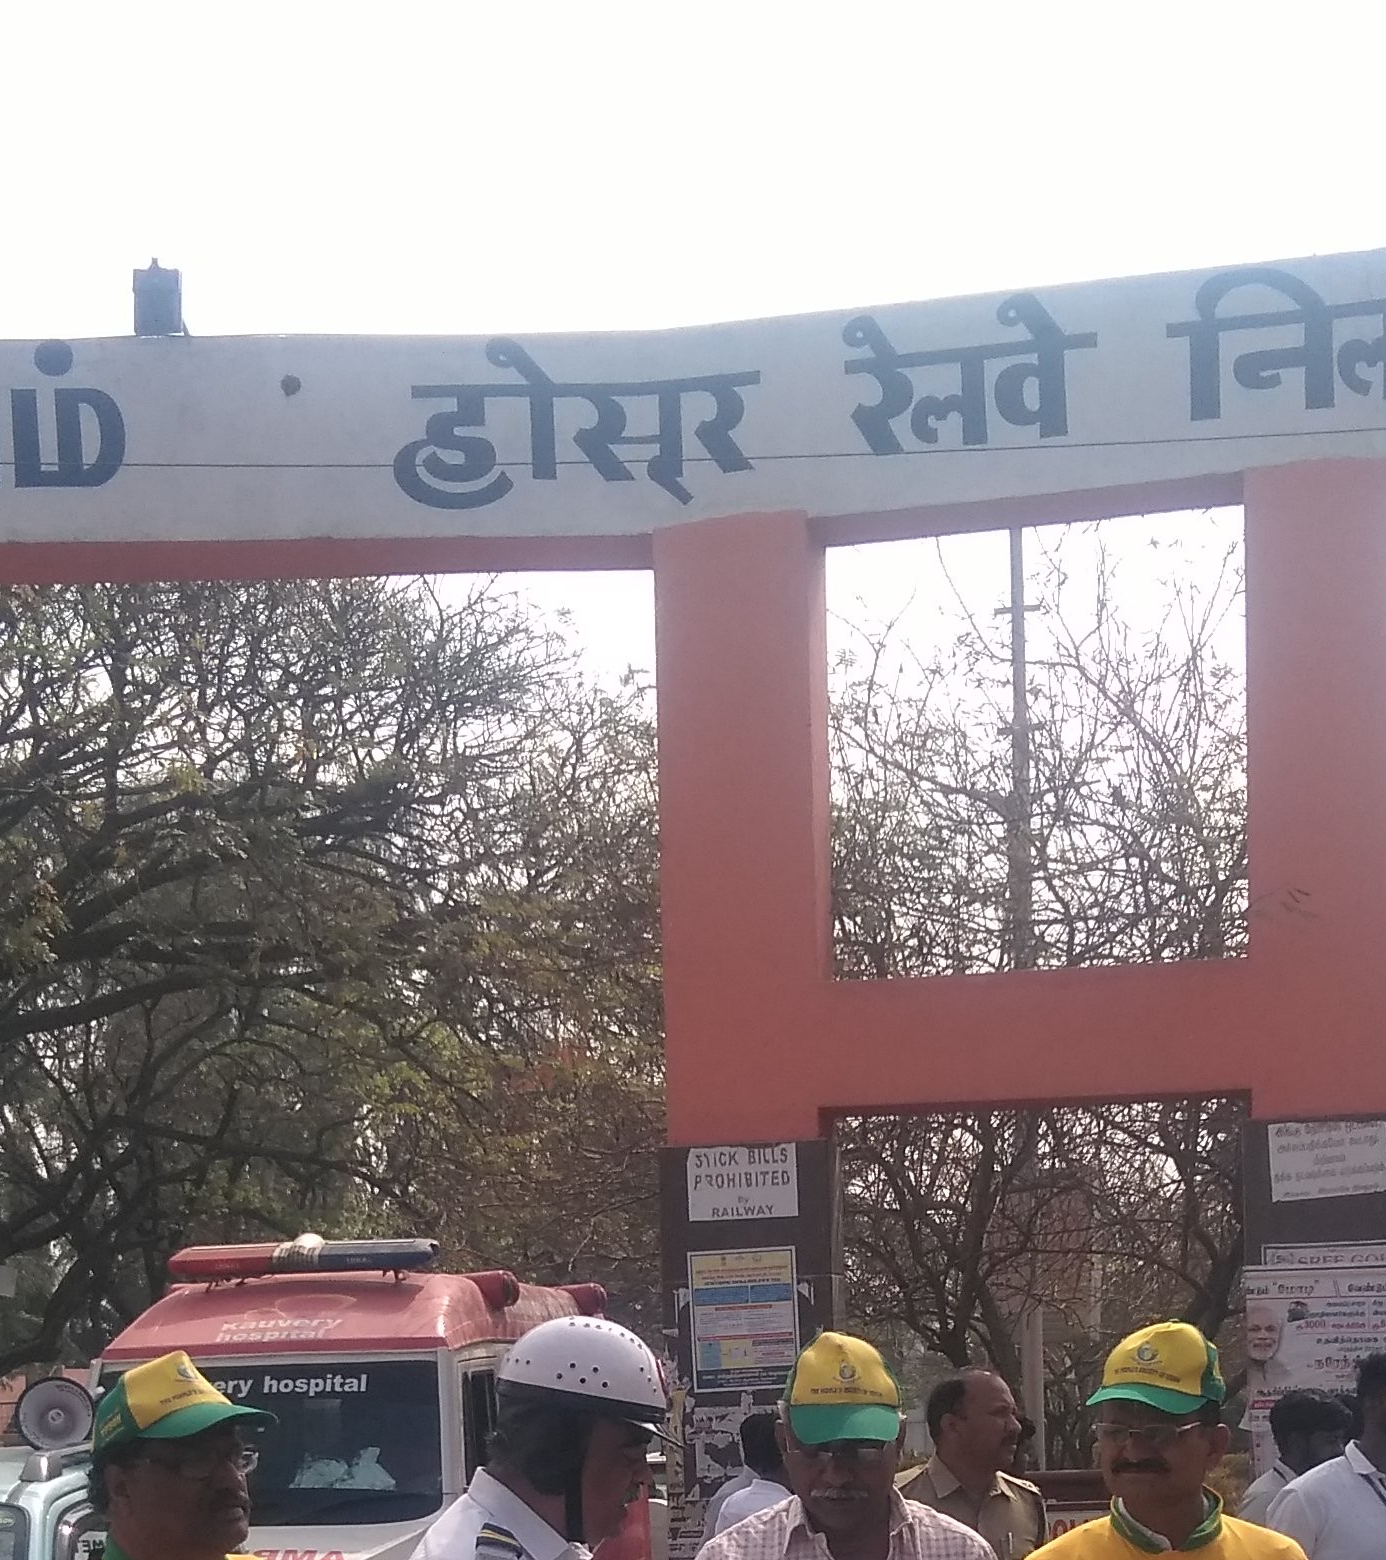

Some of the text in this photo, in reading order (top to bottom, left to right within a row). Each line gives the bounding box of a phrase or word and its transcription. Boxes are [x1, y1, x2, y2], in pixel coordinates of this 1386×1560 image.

[843, 292, 1099, 457] रेलवे
[747, 1147, 789, 1166] BILLS
[693, 1170, 791, 1191] PROHIBITED
[711, 1204, 774, 1218] RAILWAY
[214, 1327, 326, 1343] hospital
[262, 1373, 368, 1397] hospital
